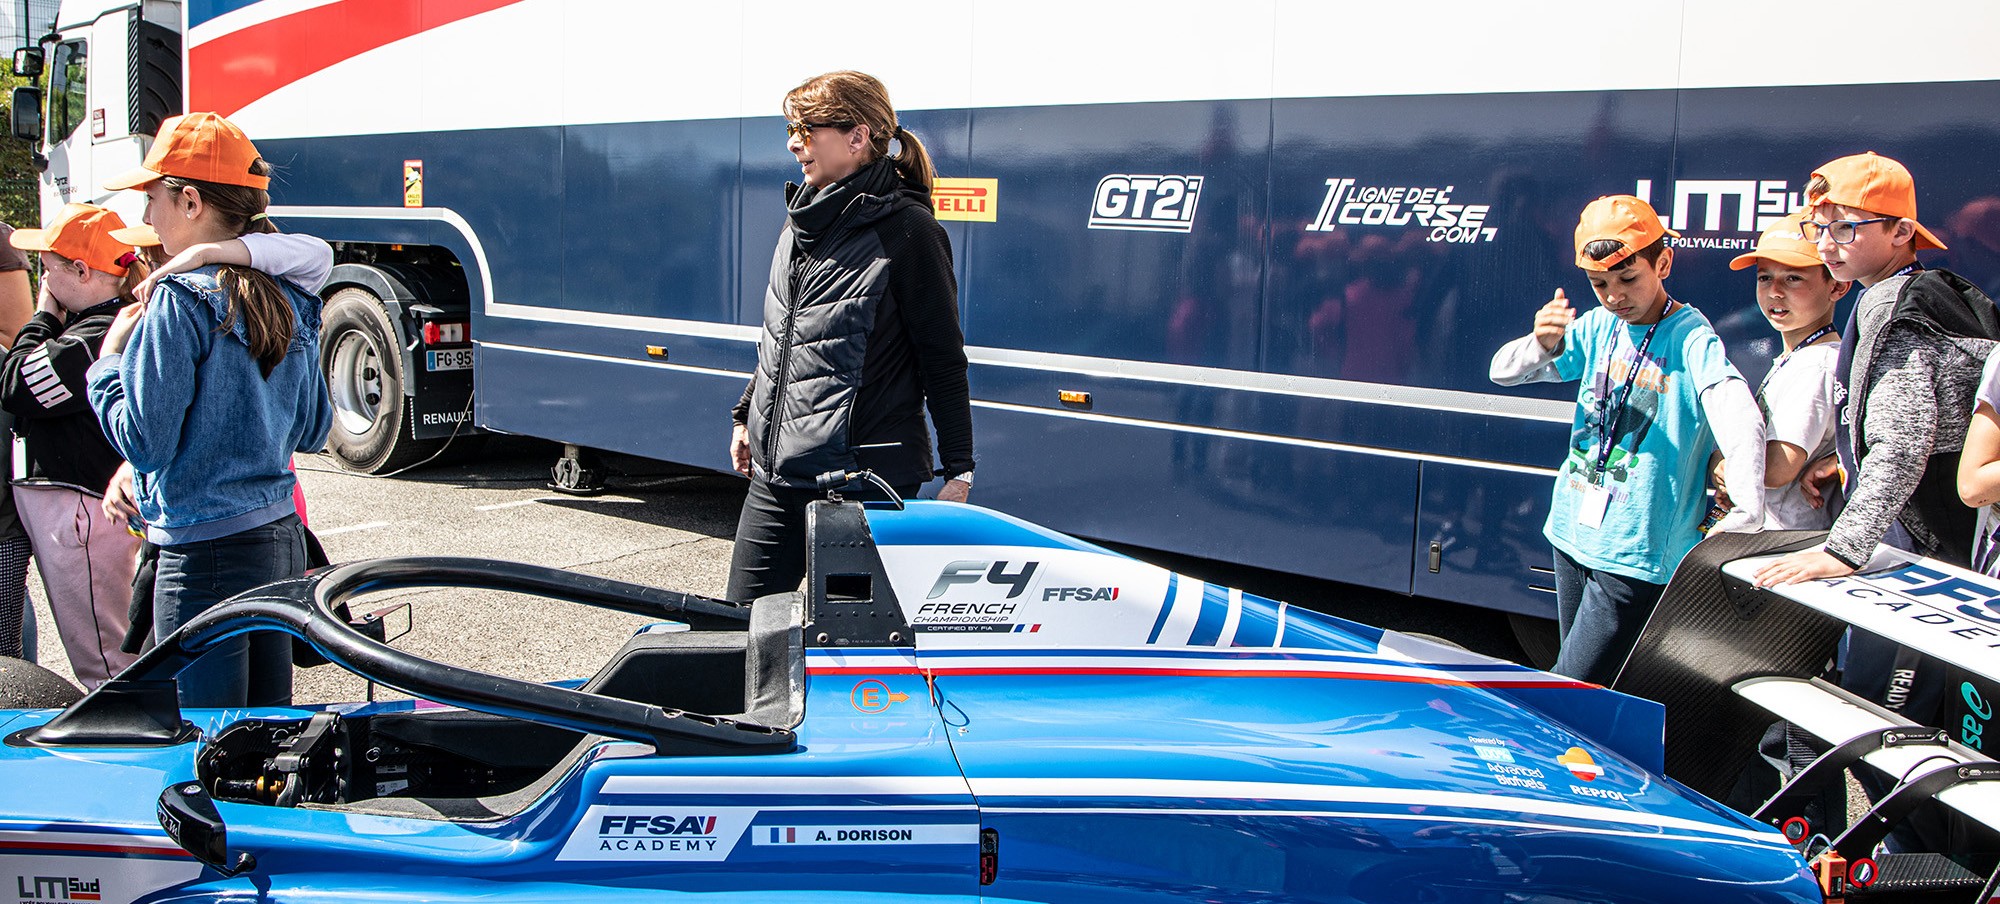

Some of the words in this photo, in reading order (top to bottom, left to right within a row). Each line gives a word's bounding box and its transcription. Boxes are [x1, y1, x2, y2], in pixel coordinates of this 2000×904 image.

[1096, 179, 1199, 220] GT2i
[1345, 187, 1406, 204] LIGNE
[1404, 188, 1437, 205] DE
[930, 198, 985, 212] ELLI
[1338, 203, 1490, 228] COURSE
[1671, 237, 1748, 249] POLYVALENT
[436, 351, 474, 367] FG-95
[423, 411, 473, 425] RENAULT
[926, 560, 1039, 599] F4
[918, 603, 1017, 615] FRENCH
[1885, 669, 1916, 709] READY
[1487, 762, 1545, 778] Advanced
[1494, 774, 1547, 790] Biofuels
[1569, 784, 1628, 801] REPSOL
[815, 830, 832, 841] A.
[838, 830, 912, 841] DORISON
[600, 840, 717, 851] ACADEMY
